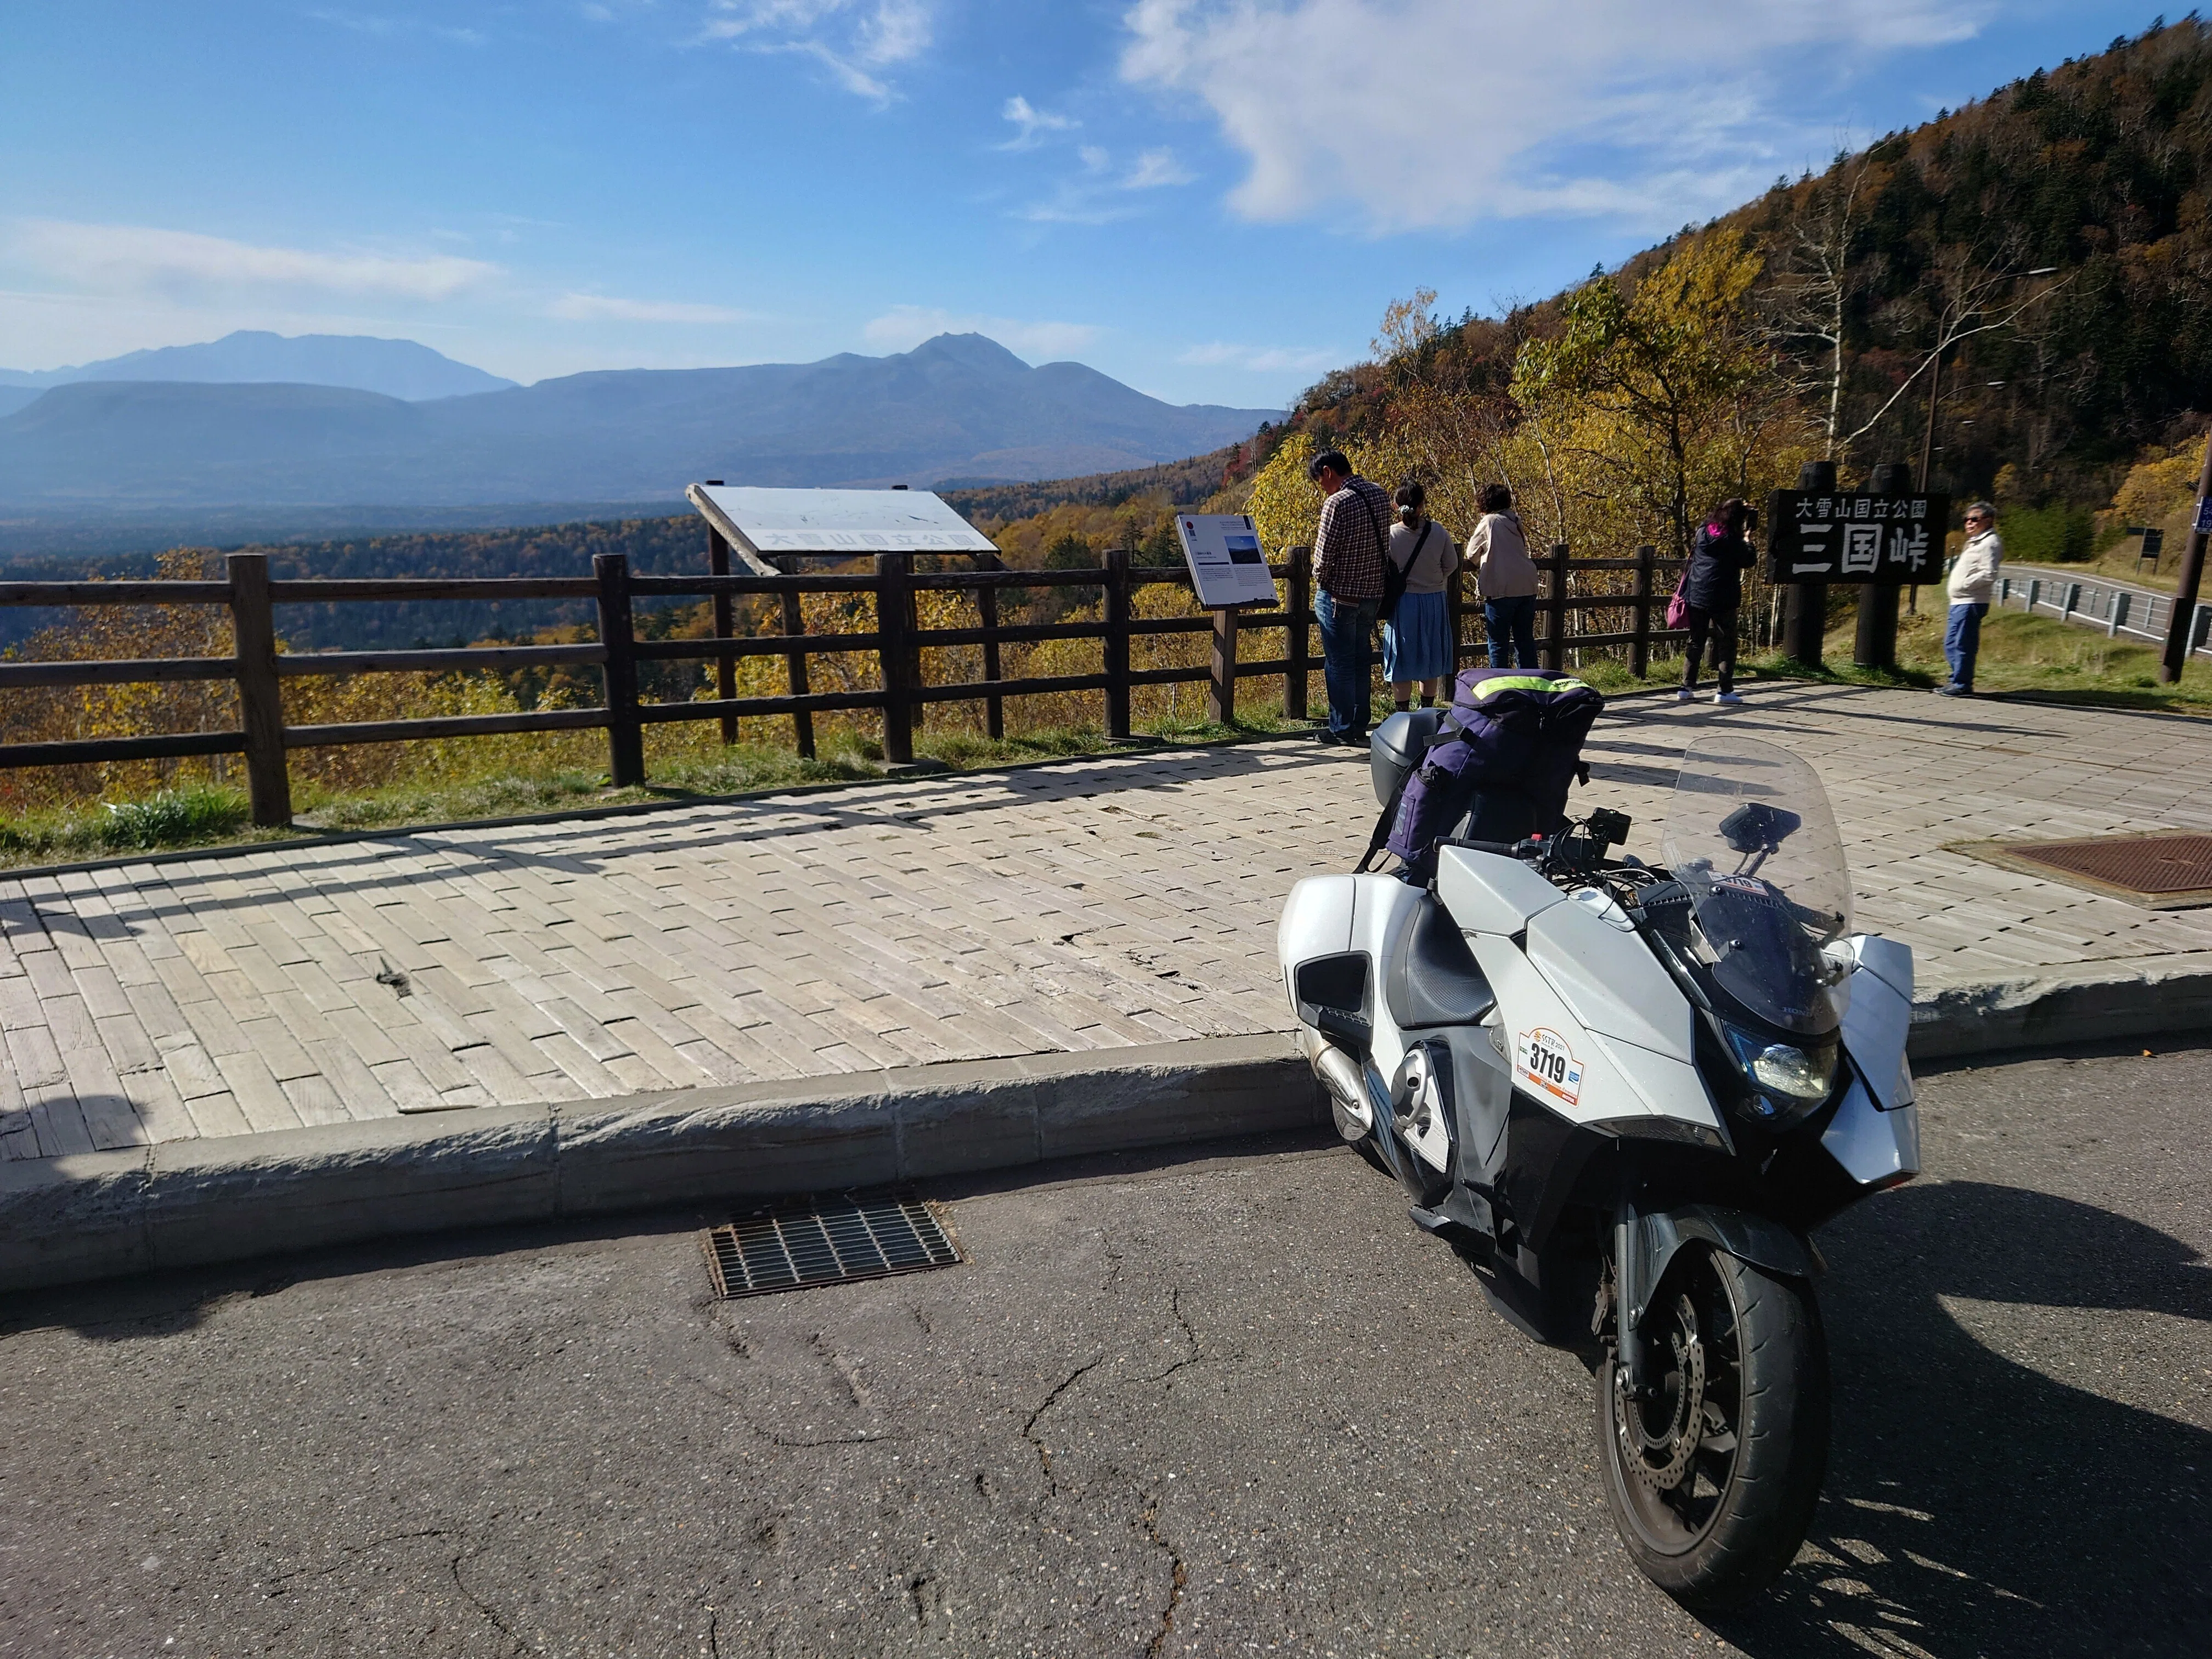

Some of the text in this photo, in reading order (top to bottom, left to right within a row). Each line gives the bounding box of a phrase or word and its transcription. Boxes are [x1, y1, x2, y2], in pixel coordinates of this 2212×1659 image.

[1796, 497, 1927, 518] 大雪山国立公園
[765, 533, 977, 546] 大雪山国立公園
[1792, 523, 1930, 574] 三国峠
[1542, 1034, 1556, 1047] SSTR
[1555, 1042, 1565, 1051] 2021
[1530, 1043, 1566, 1084] 3719
